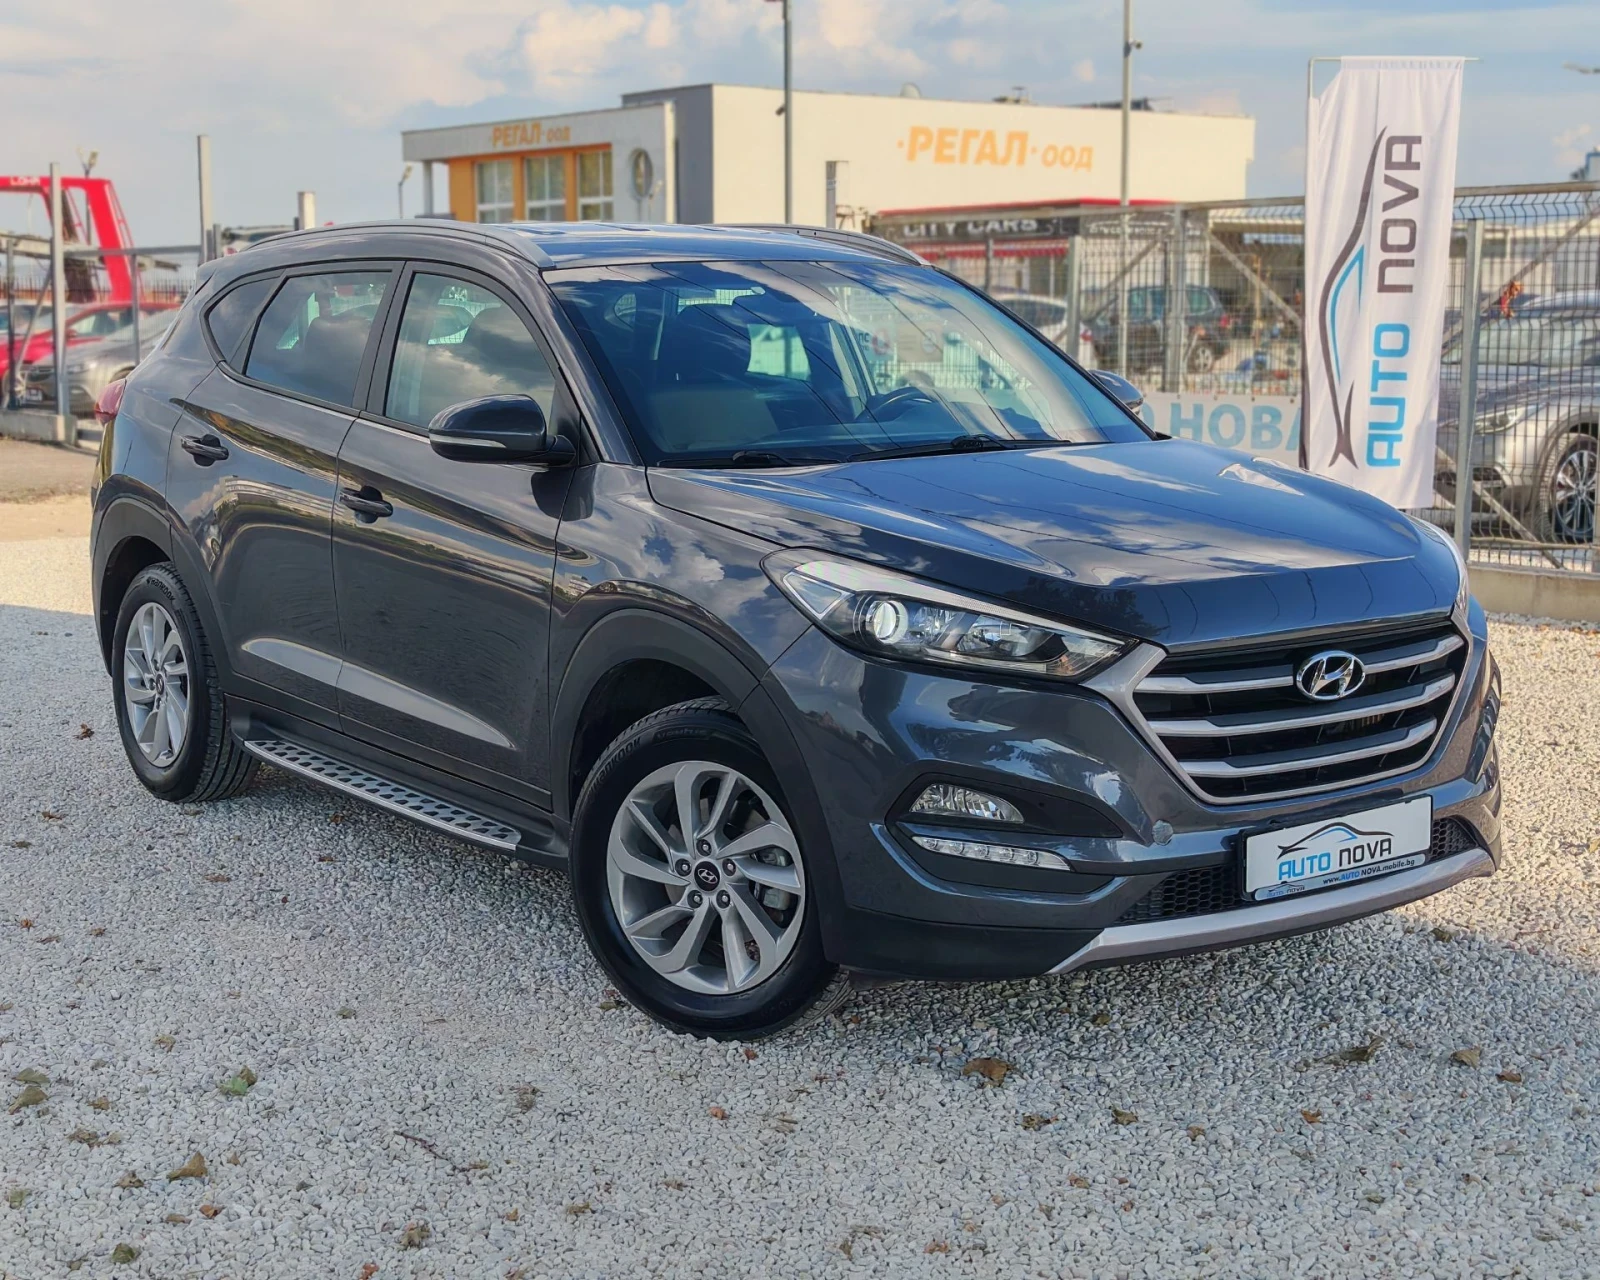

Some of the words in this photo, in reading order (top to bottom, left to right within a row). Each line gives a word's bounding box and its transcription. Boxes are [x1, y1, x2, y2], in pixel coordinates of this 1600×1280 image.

[1377, 135, 1422, 293] NOVA
[1366, 323, 1410, 467] AUTO
[1278, 852, 1331, 880] AUTO
[1339, 837, 1392, 867] NOVA
